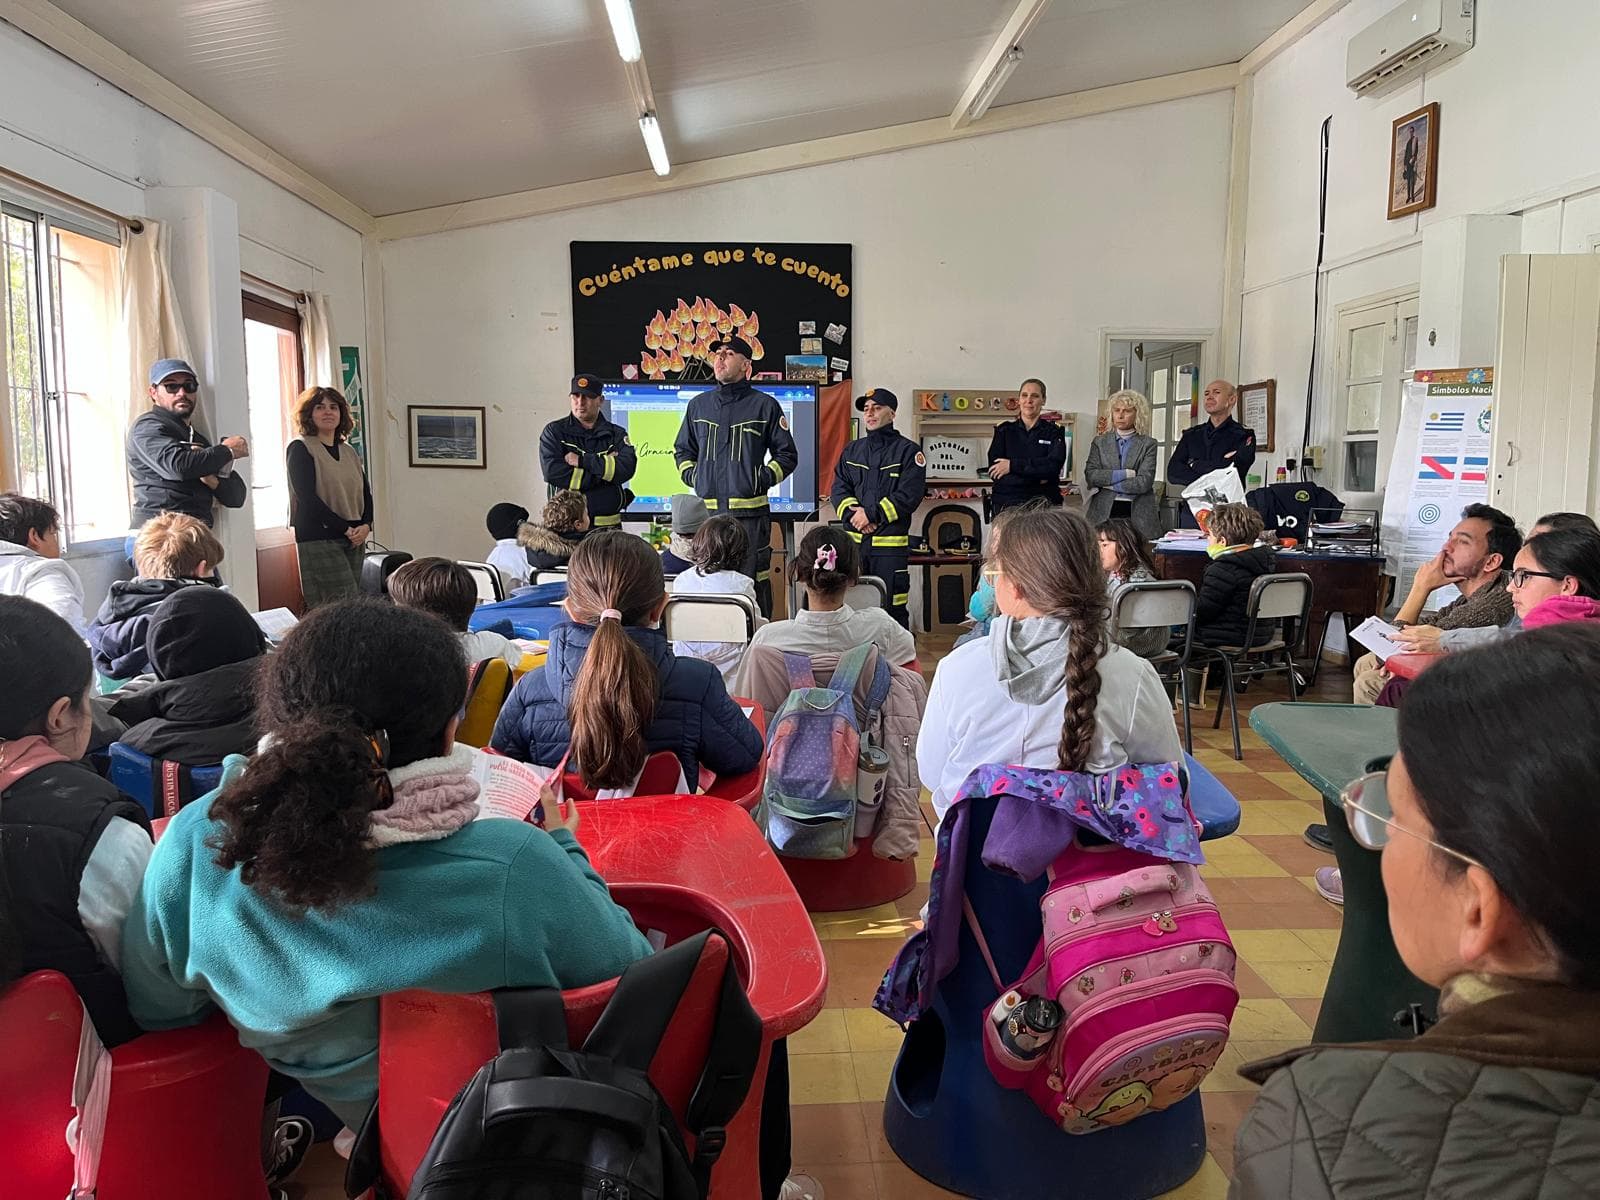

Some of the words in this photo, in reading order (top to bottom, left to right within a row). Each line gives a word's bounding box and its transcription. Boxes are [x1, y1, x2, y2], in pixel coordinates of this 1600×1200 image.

[579, 252, 694, 296] Cuéntame
[704, 249, 745, 266] que
[752, 247, 776, 265] te
[781, 257, 850, 297] cuento
[640, 442, 674, 457] Gracia
[929, 441, 970, 455] HISTORIAS
